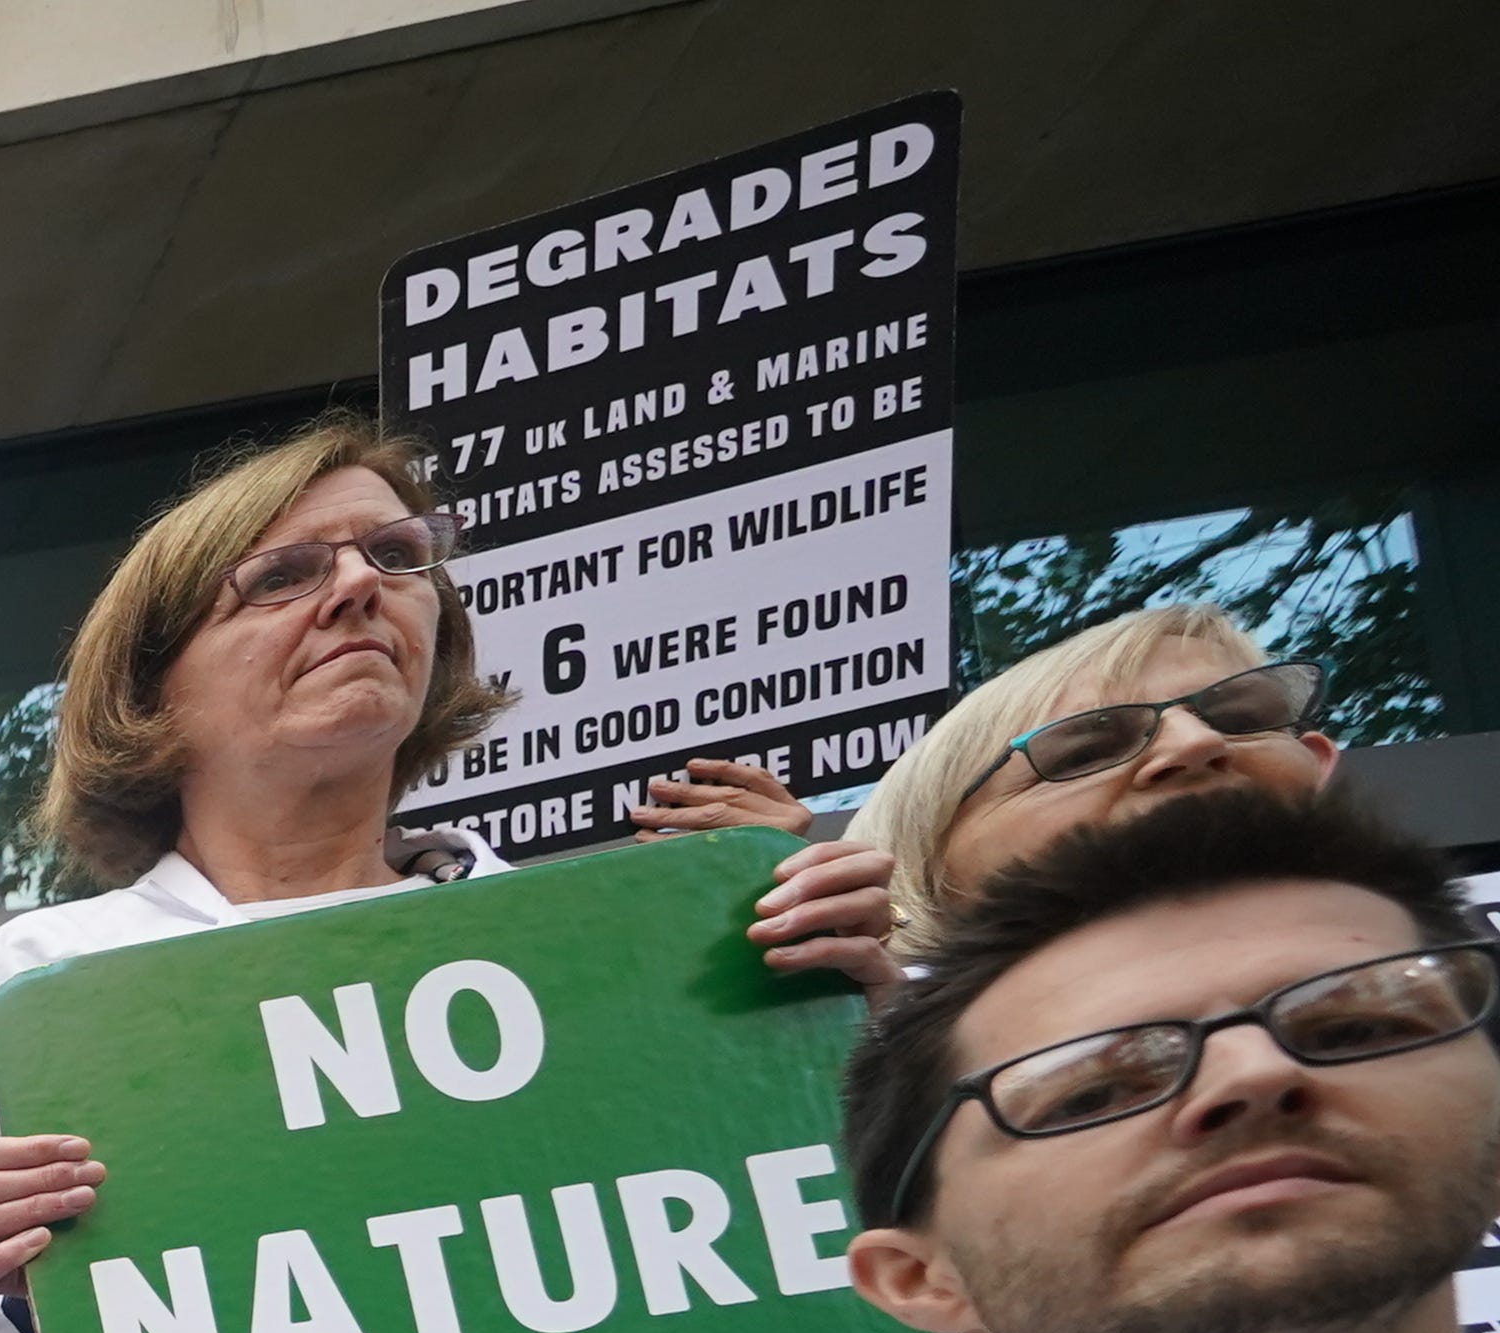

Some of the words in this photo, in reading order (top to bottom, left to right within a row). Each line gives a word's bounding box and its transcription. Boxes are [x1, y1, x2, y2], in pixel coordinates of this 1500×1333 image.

[406, 122, 935, 327] DEGRADED
[408, 213, 927, 411] HABITATS
[452, 426, 503, 475] 77
[524, 421, 566, 456] UK
[584, 383, 686, 440] LAND
[758, 314, 929, 388] MARINE
[638, 521, 712, 573] FOR
[728, 466, 927, 550] WILDLIFE
[542, 624, 586, 693] 6
[613, 616, 737, 679] WERE
[758, 575, 908, 644] FOUND
[258, 958, 546, 1132] NO
